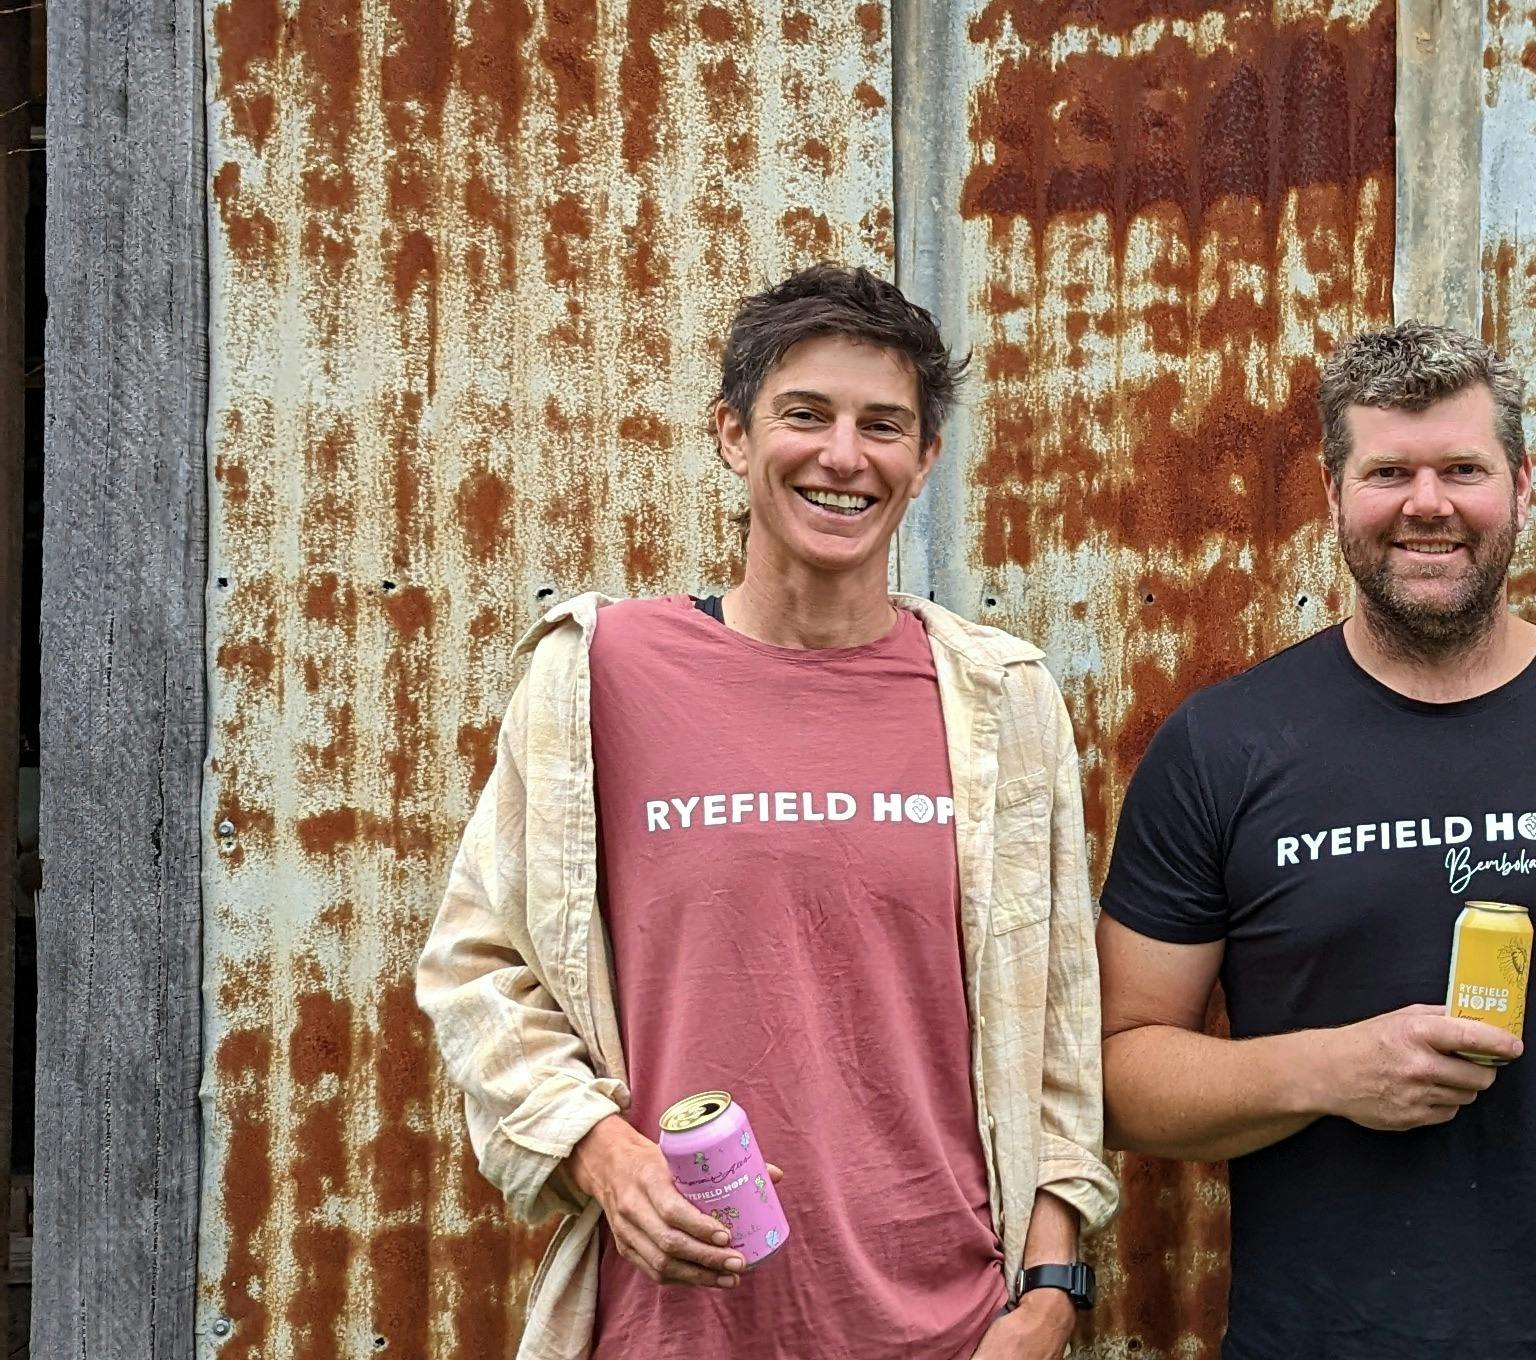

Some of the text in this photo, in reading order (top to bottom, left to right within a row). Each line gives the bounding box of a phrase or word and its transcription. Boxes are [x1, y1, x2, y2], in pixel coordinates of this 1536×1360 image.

[646, 791, 955, 832] RYEFIELD HOP
[1276, 816, 1473, 867] RYEFIELD
[1459, 983, 1509, 998] RYEFIELD
[1457, 993, 1508, 1012] HOPS
[724, 1174, 749, 1193] HOPS
